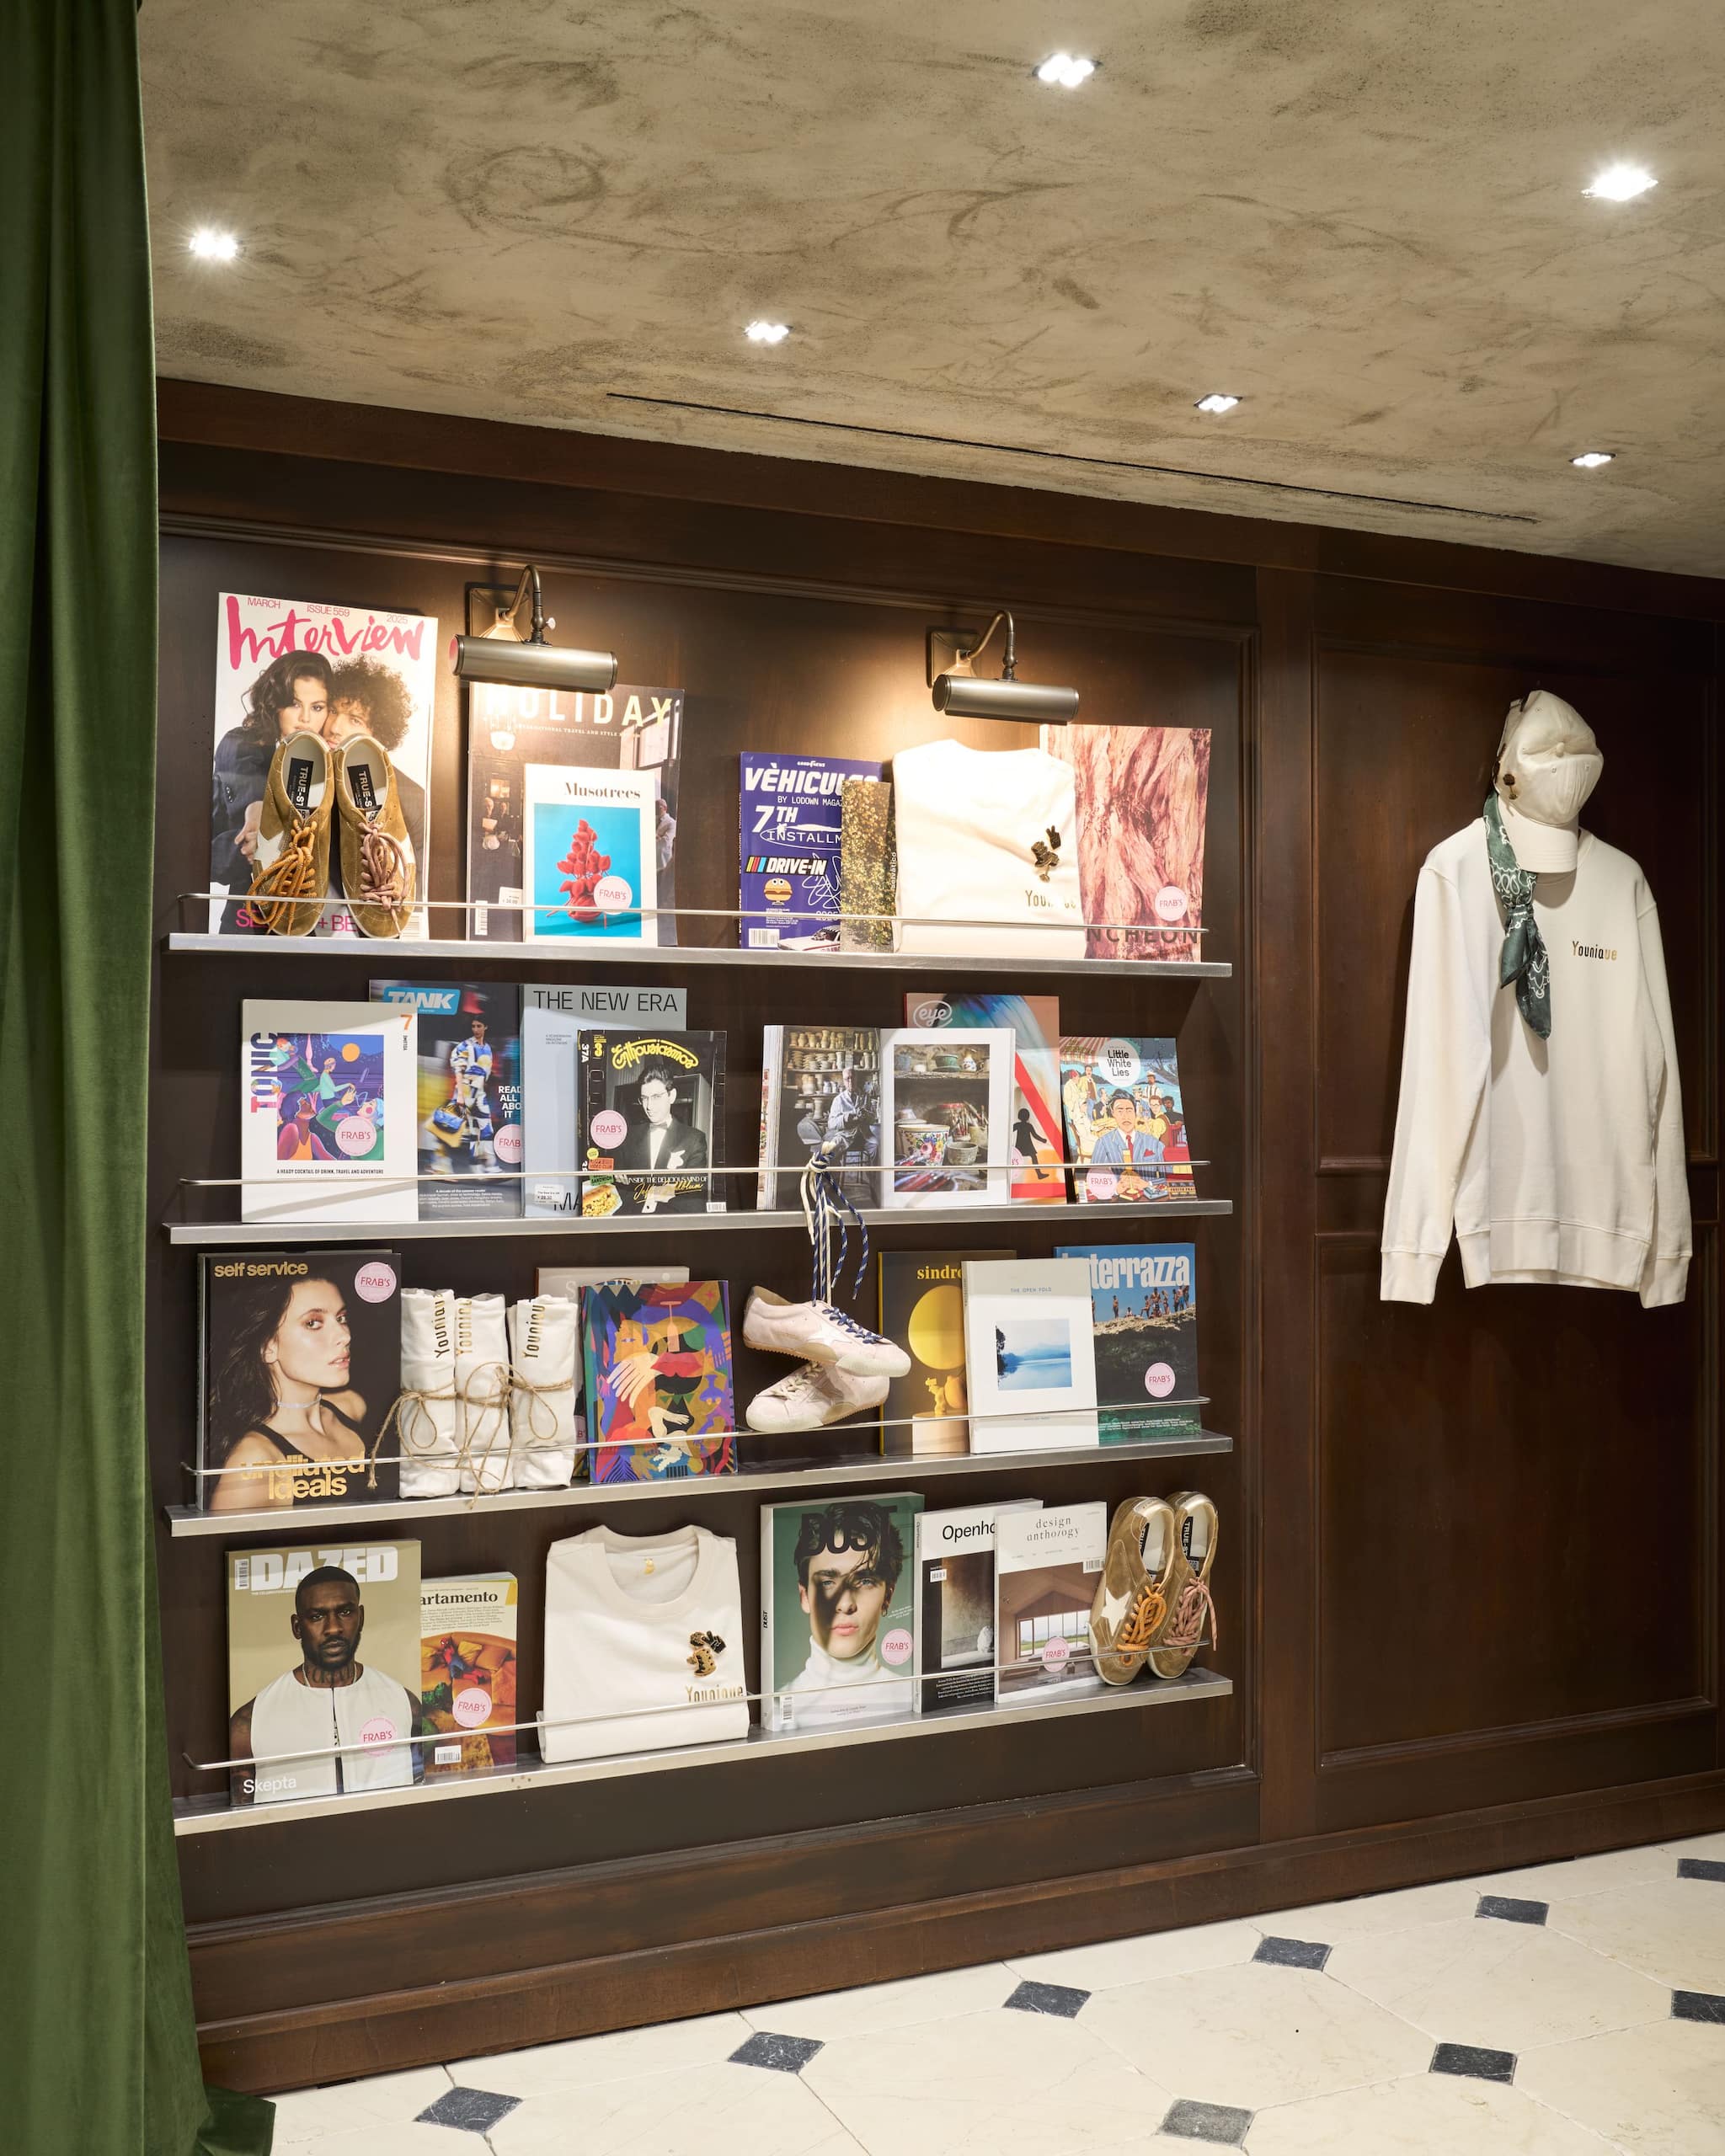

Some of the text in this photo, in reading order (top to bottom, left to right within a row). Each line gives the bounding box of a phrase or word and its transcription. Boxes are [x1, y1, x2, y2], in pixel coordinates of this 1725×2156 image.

[247, 597, 409, 624] MARCH ISSUE 559 2025
[227, 595, 425, 670] Interview
[486, 690, 672, 727] OLIDAY
[564, 782, 641, 799] Musotrees
[792, 797, 820, 806] LODOWN
[766, 857, 828, 876] DRIVE-IN
[599, 889, 627, 902] FRAB'S
[1159, 898, 1183, 909] FRAB'S
[1572, 940, 1617, 961] Younique
[388, 991, 456, 1009] TANK
[533, 990, 678, 1011] THE NEW ERA
[400, 1014, 413, 1031] 7
[919, 1008, 947, 1027] eye
[581, 1043, 590, 1063] 37A
[1108, 1049, 1130, 1059] Little
[1107, 1059, 1132, 1068] White
[250, 1033, 279, 1113] TONIC
[1112, 1068, 1130, 1076] Lies
[341, 1131, 371, 1140] FRAB'S
[595, 1124, 622, 1134] FRAB'S
[214, 1261, 308, 1278] self service
[360, 1277, 391, 1288] FRAB'S
[1148, 1375, 1172, 1384] FRAB'S
[1035, 1516, 1072, 1529] design
[1027, 1527, 1081, 1542] anthology
[885, 1642, 910, 1651] FRAB'S
[1045, 1648, 1066, 1658] FRAB'S
[458, 1701, 486, 1712] FRAB'S
[362, 1731, 393, 1743] FRAB'S
[243, 1774, 296, 1794] Skepta
